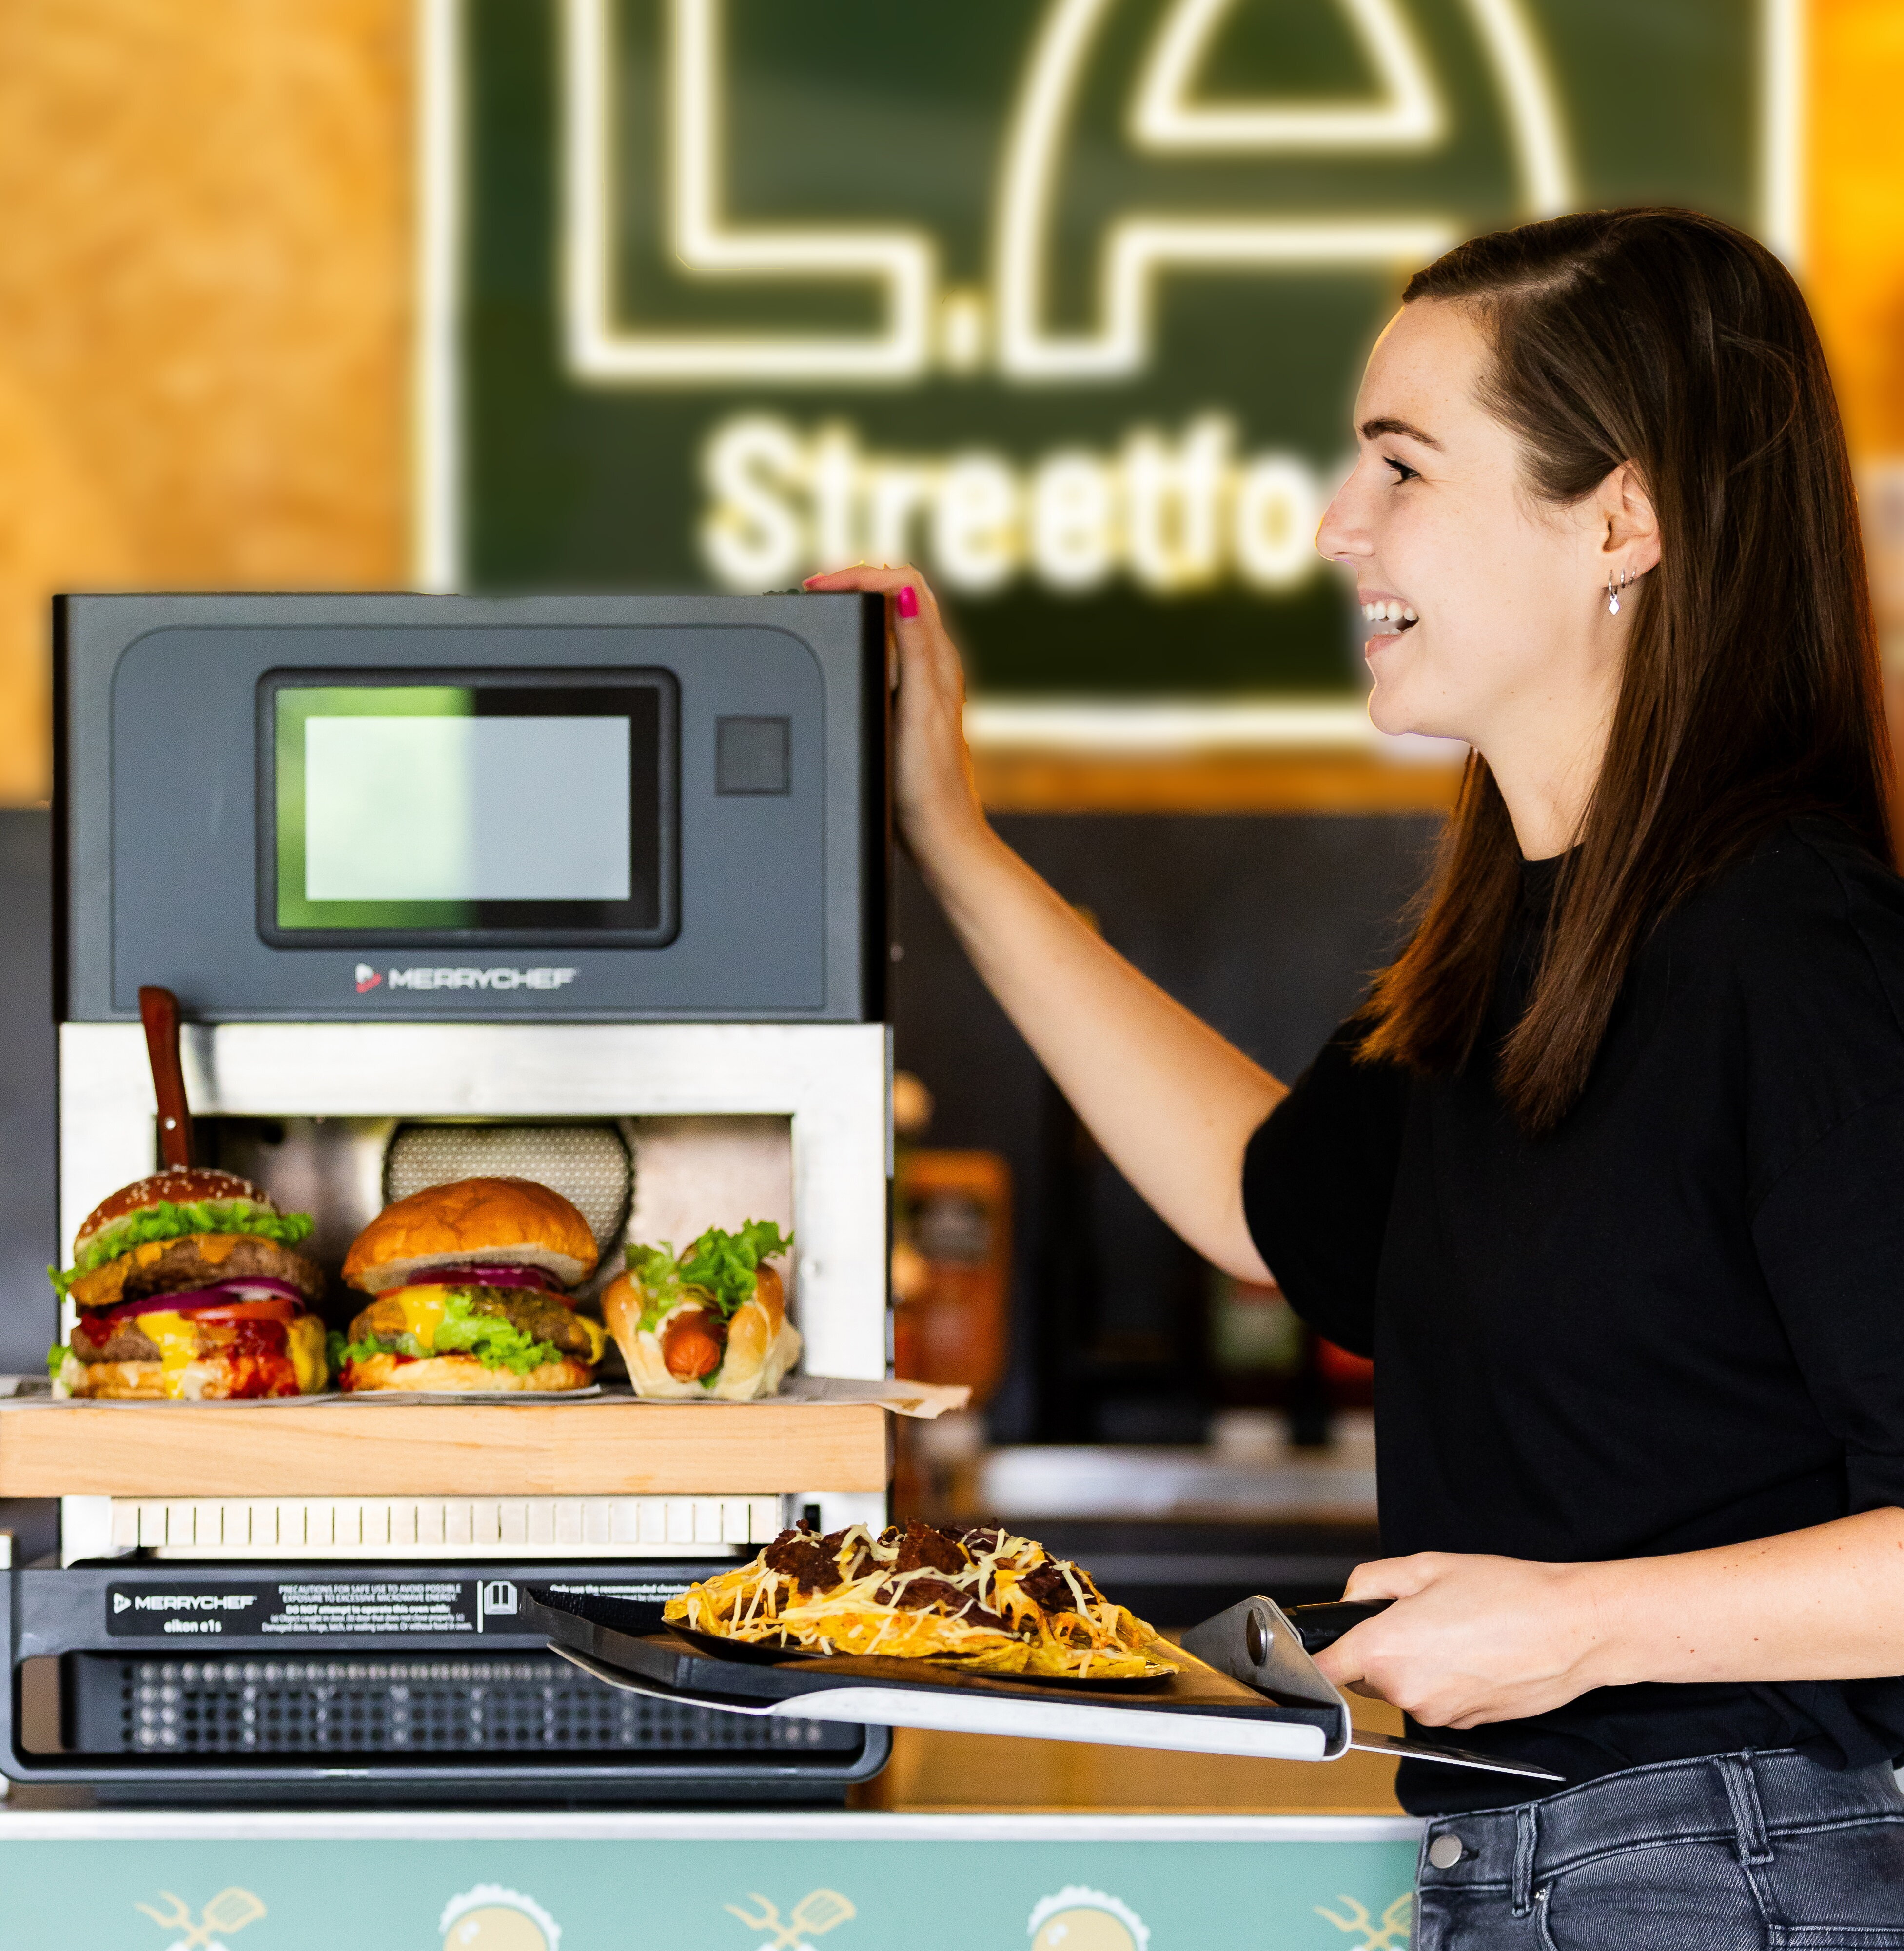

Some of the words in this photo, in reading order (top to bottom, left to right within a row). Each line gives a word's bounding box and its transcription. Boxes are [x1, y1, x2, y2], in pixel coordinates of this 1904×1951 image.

[702, 419, 1334, 591] Streetfo
[389, 968, 578, 989] MERRYCHEF
[135, 1596, 254, 1610] MERRYCHEF
[286, 1605, 299, 1614] DO
[300, 1605, 317, 1614] NOT
[164, 1619, 198, 1632] eikon
[200, 1619, 222, 1632] e1s
